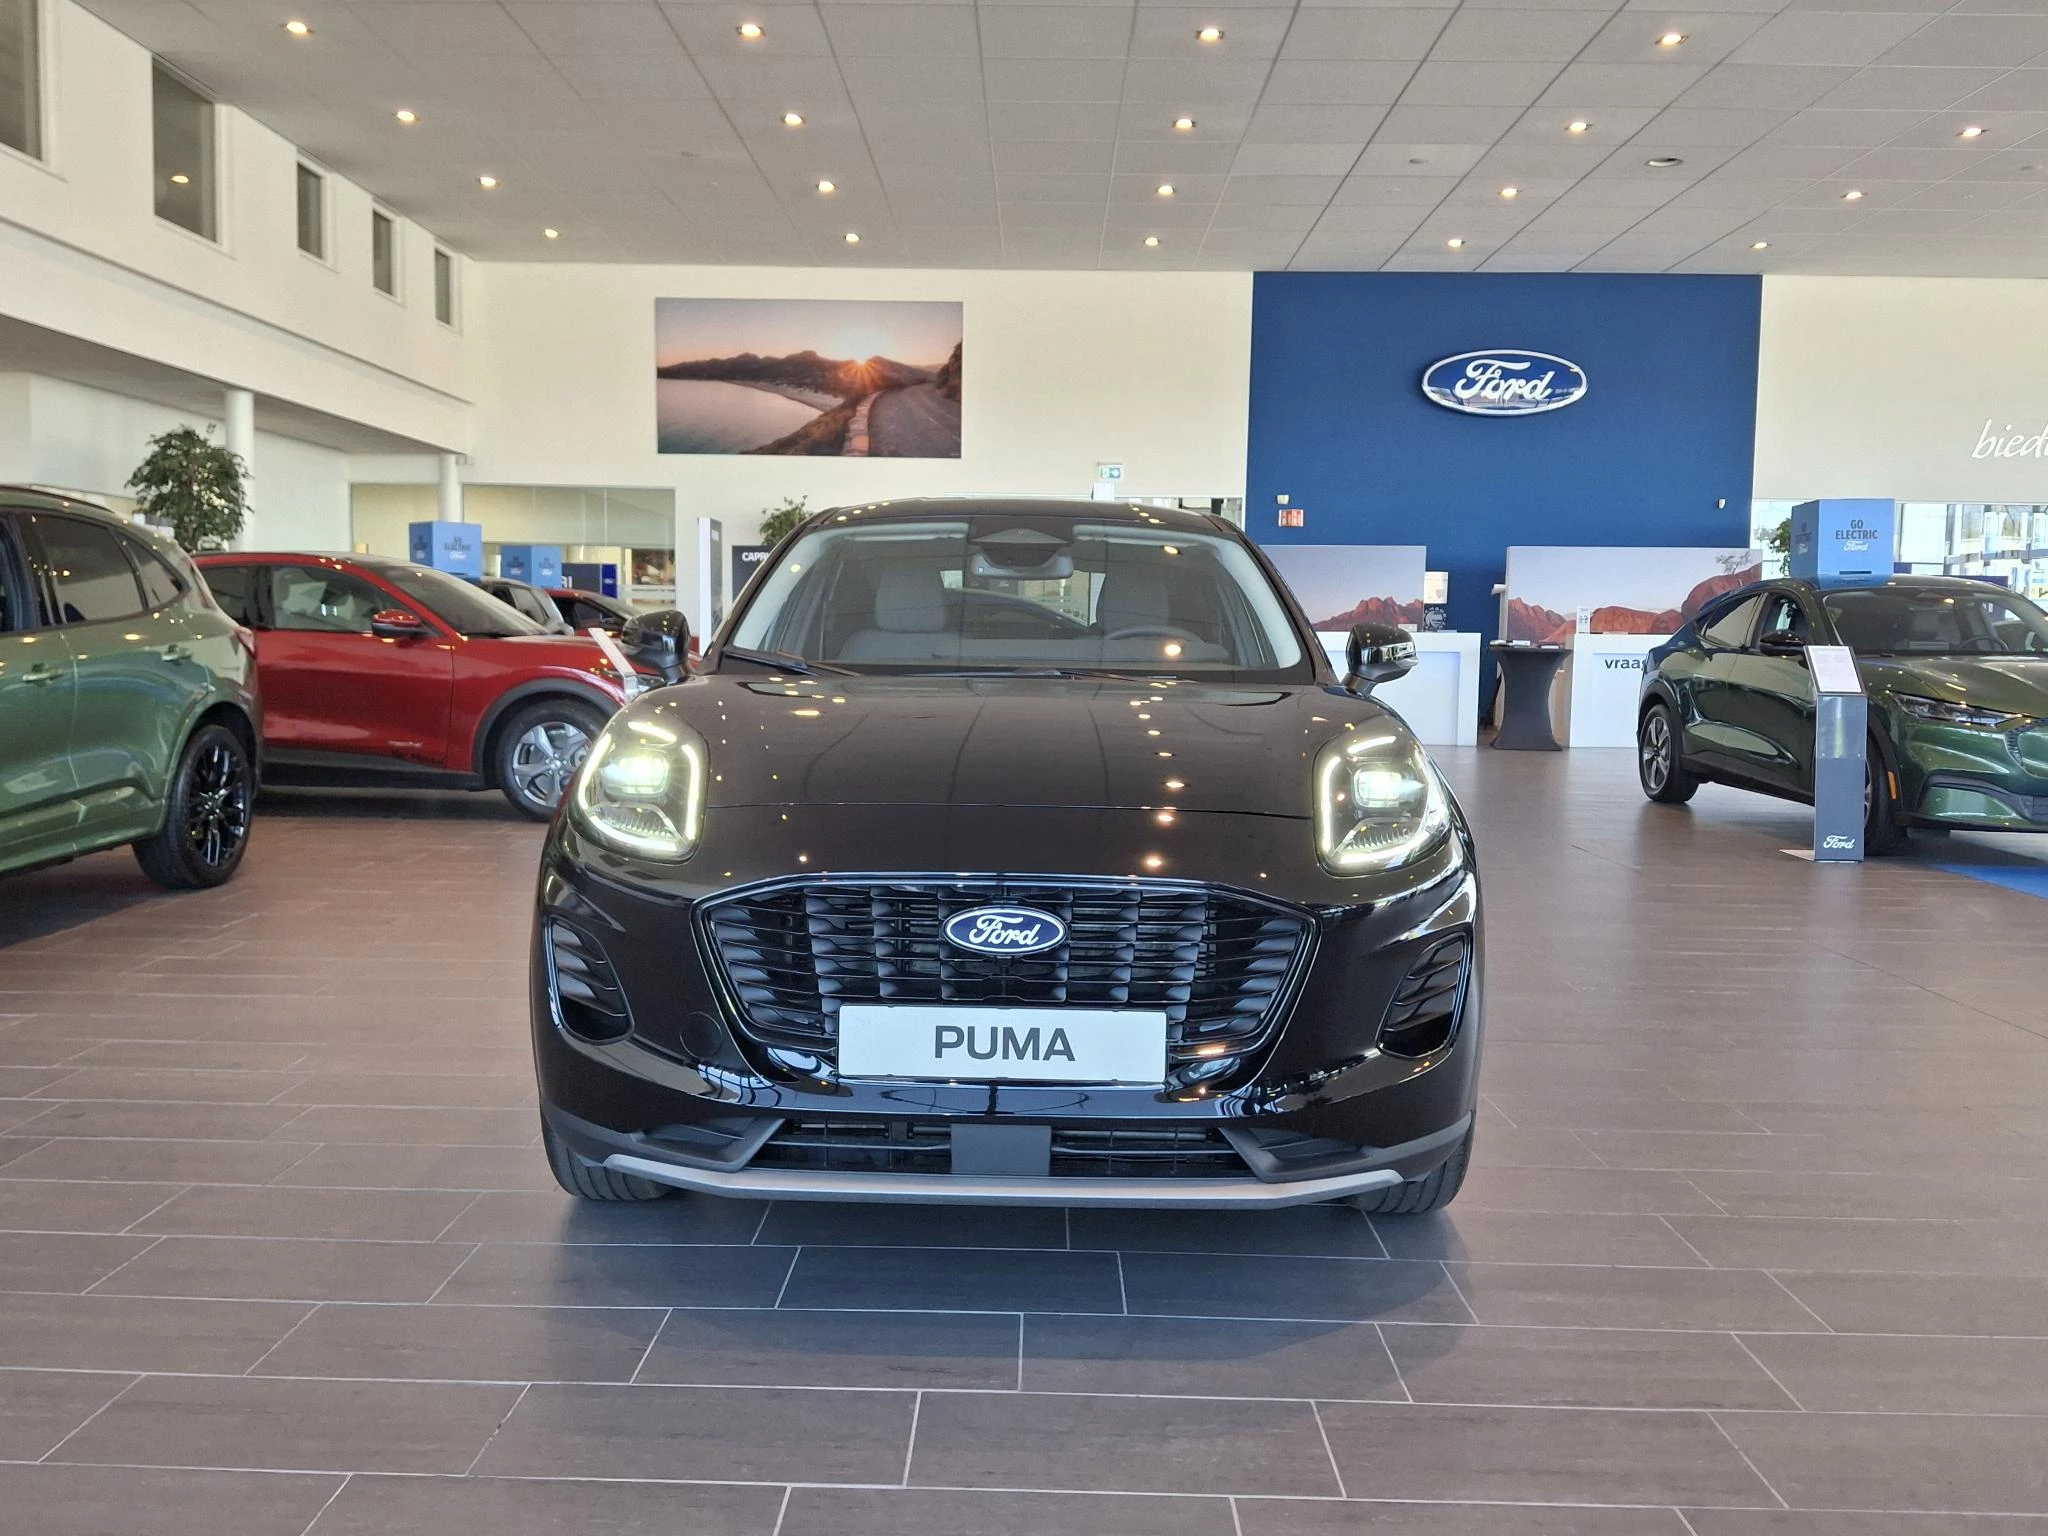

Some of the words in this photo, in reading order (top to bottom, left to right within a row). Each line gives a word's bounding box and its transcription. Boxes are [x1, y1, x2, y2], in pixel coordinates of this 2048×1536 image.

[1455, 358, 1556, 400] Ford
[1971, 418, 2048, 459] bied
[1850, 519, 1864, 530] GO
[1835, 529, 1879, 541] ELECTRIC
[1843, 540, 1869, 552] Ford
[1604, 658, 1646, 671] vraa
[1823, 835, 1856, 849] Ford
[968, 914, 1042, 946] Ford
[934, 1025, 1076, 1062] PUMA
